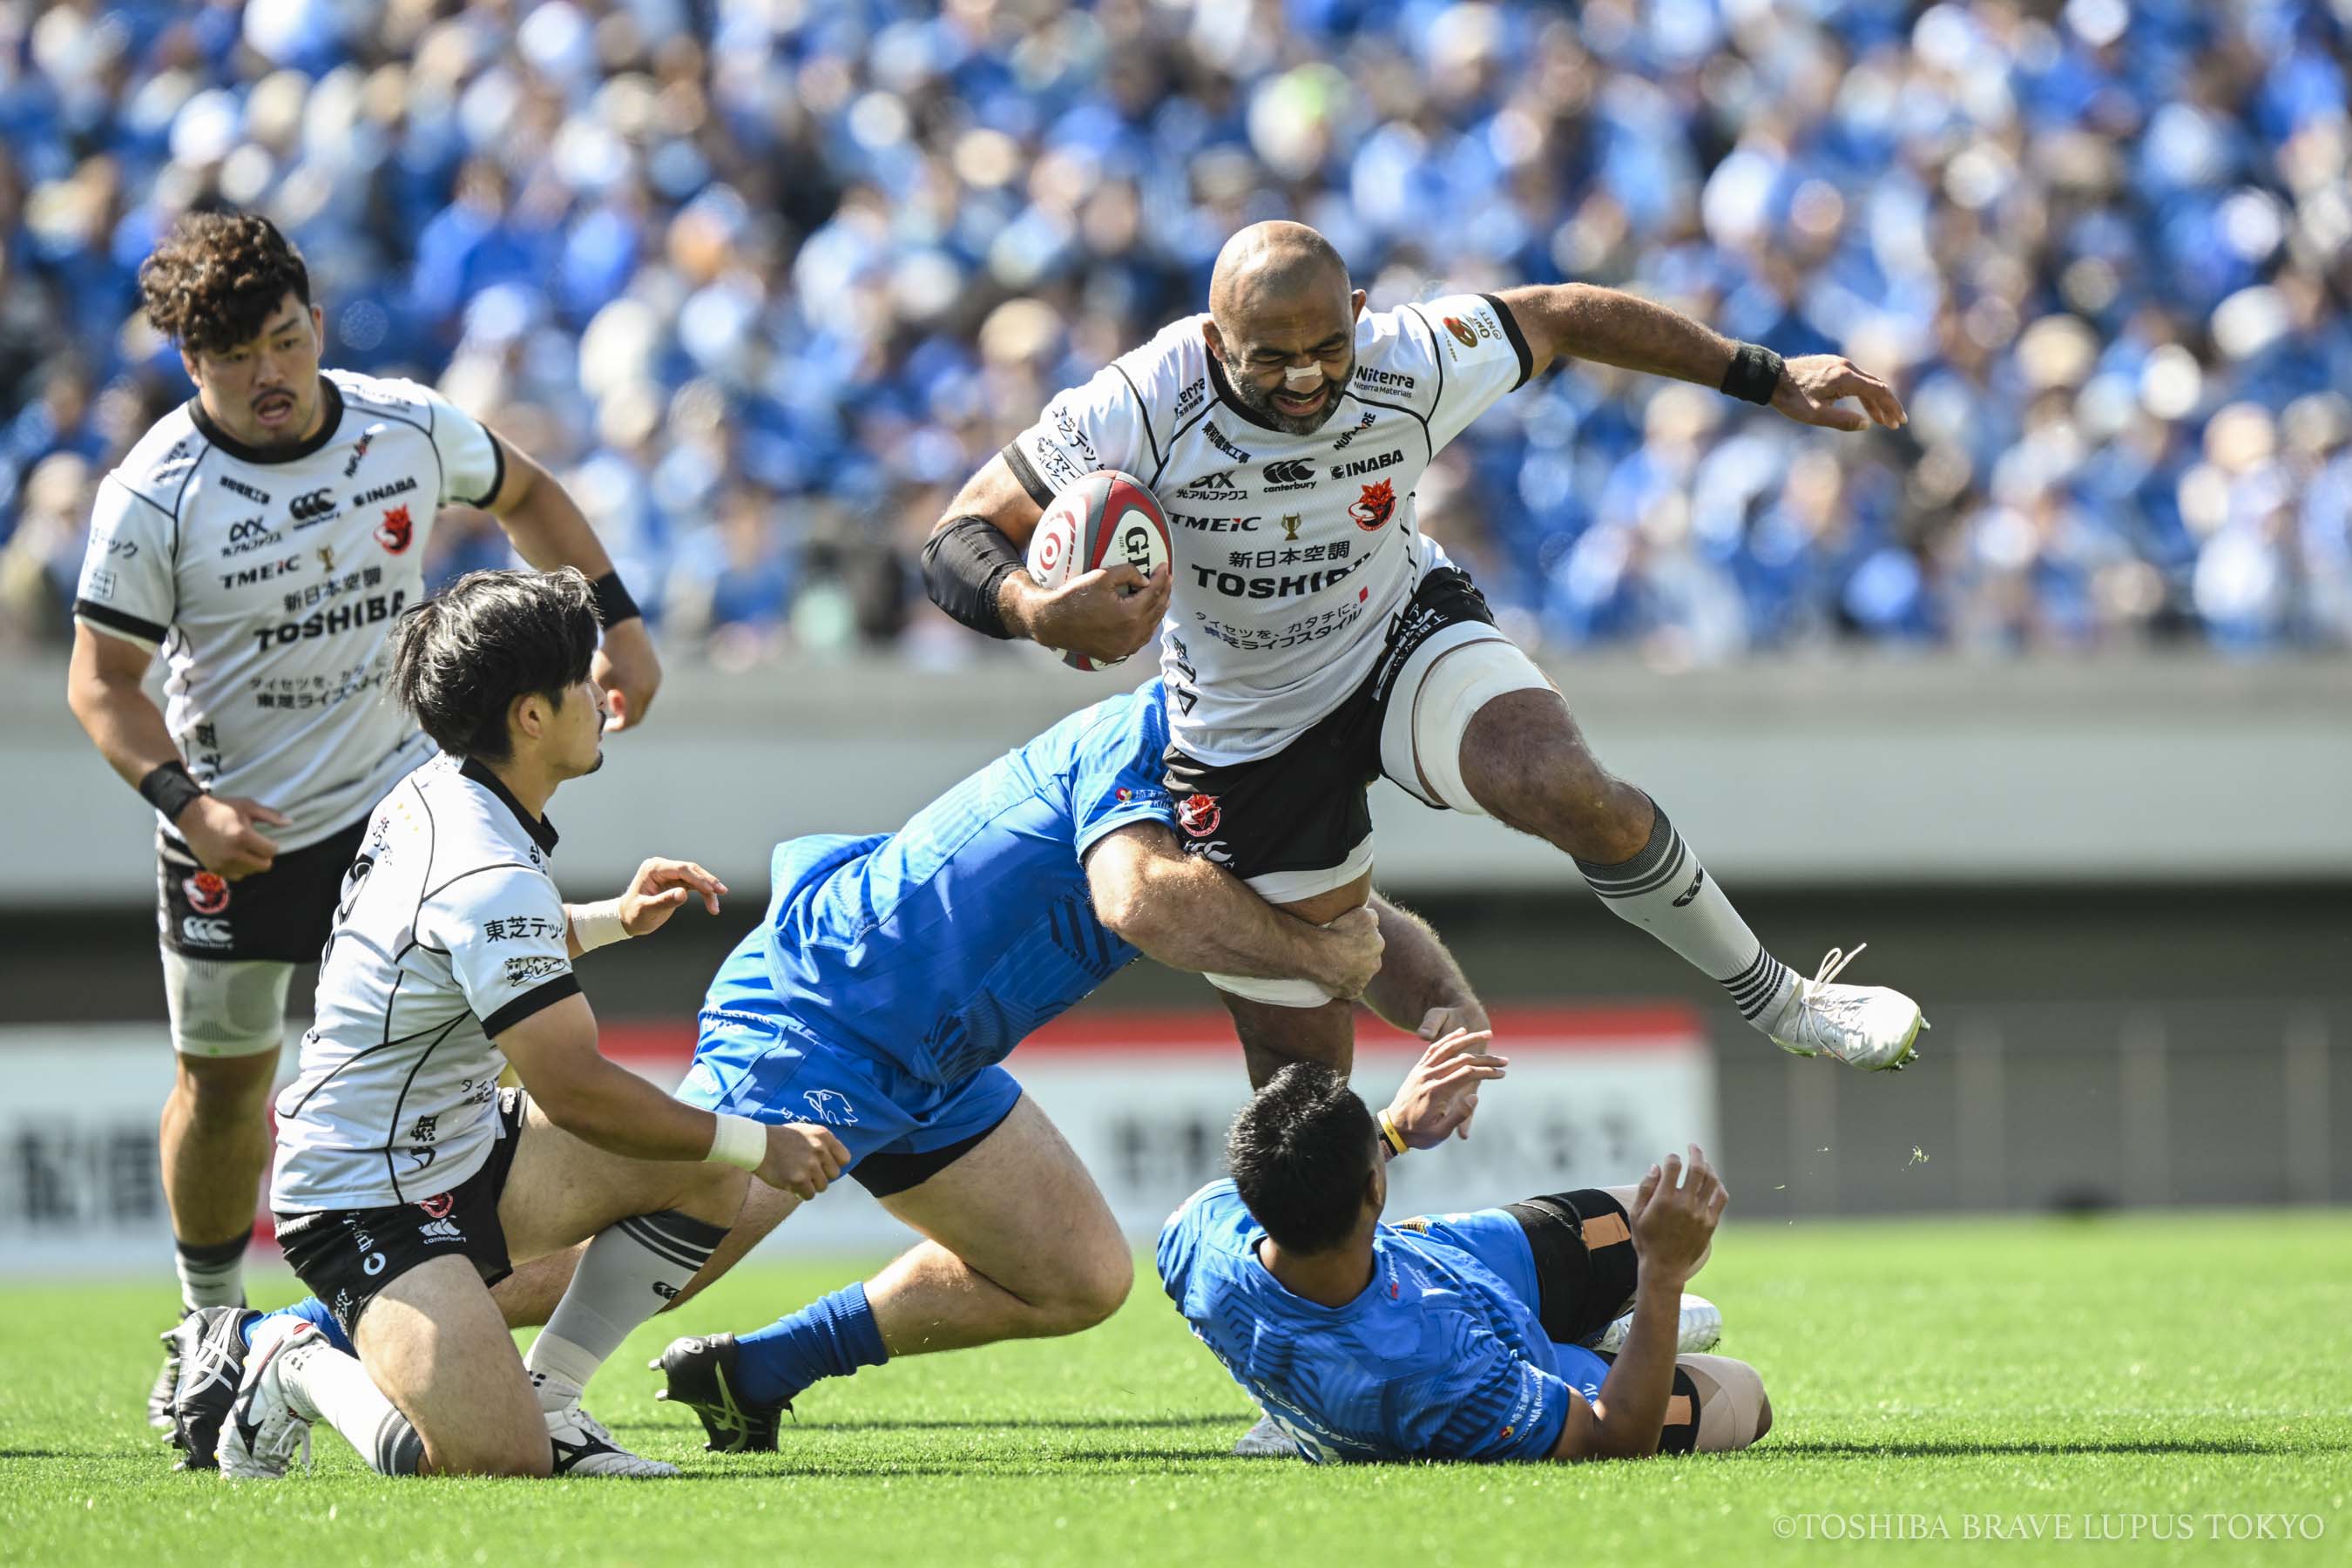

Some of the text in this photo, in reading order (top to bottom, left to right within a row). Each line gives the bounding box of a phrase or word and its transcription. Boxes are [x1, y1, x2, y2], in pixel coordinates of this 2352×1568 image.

[1354, 382, 1412, 398] Niterra Materials
[1355, 365, 1415, 389] Niterra
[1346, 449, 1404, 477] INABA
[366, 476, 418, 504] INABA
[1176, 489, 1248, 501] 光アルファクス
[1263, 481, 1317, 493] canterbury
[1228, 540, 1350, 570] 新日本空調
[1191, 551, 1372, 599] TOSHIB
[483, 916, 565, 943] 東芝テッ
